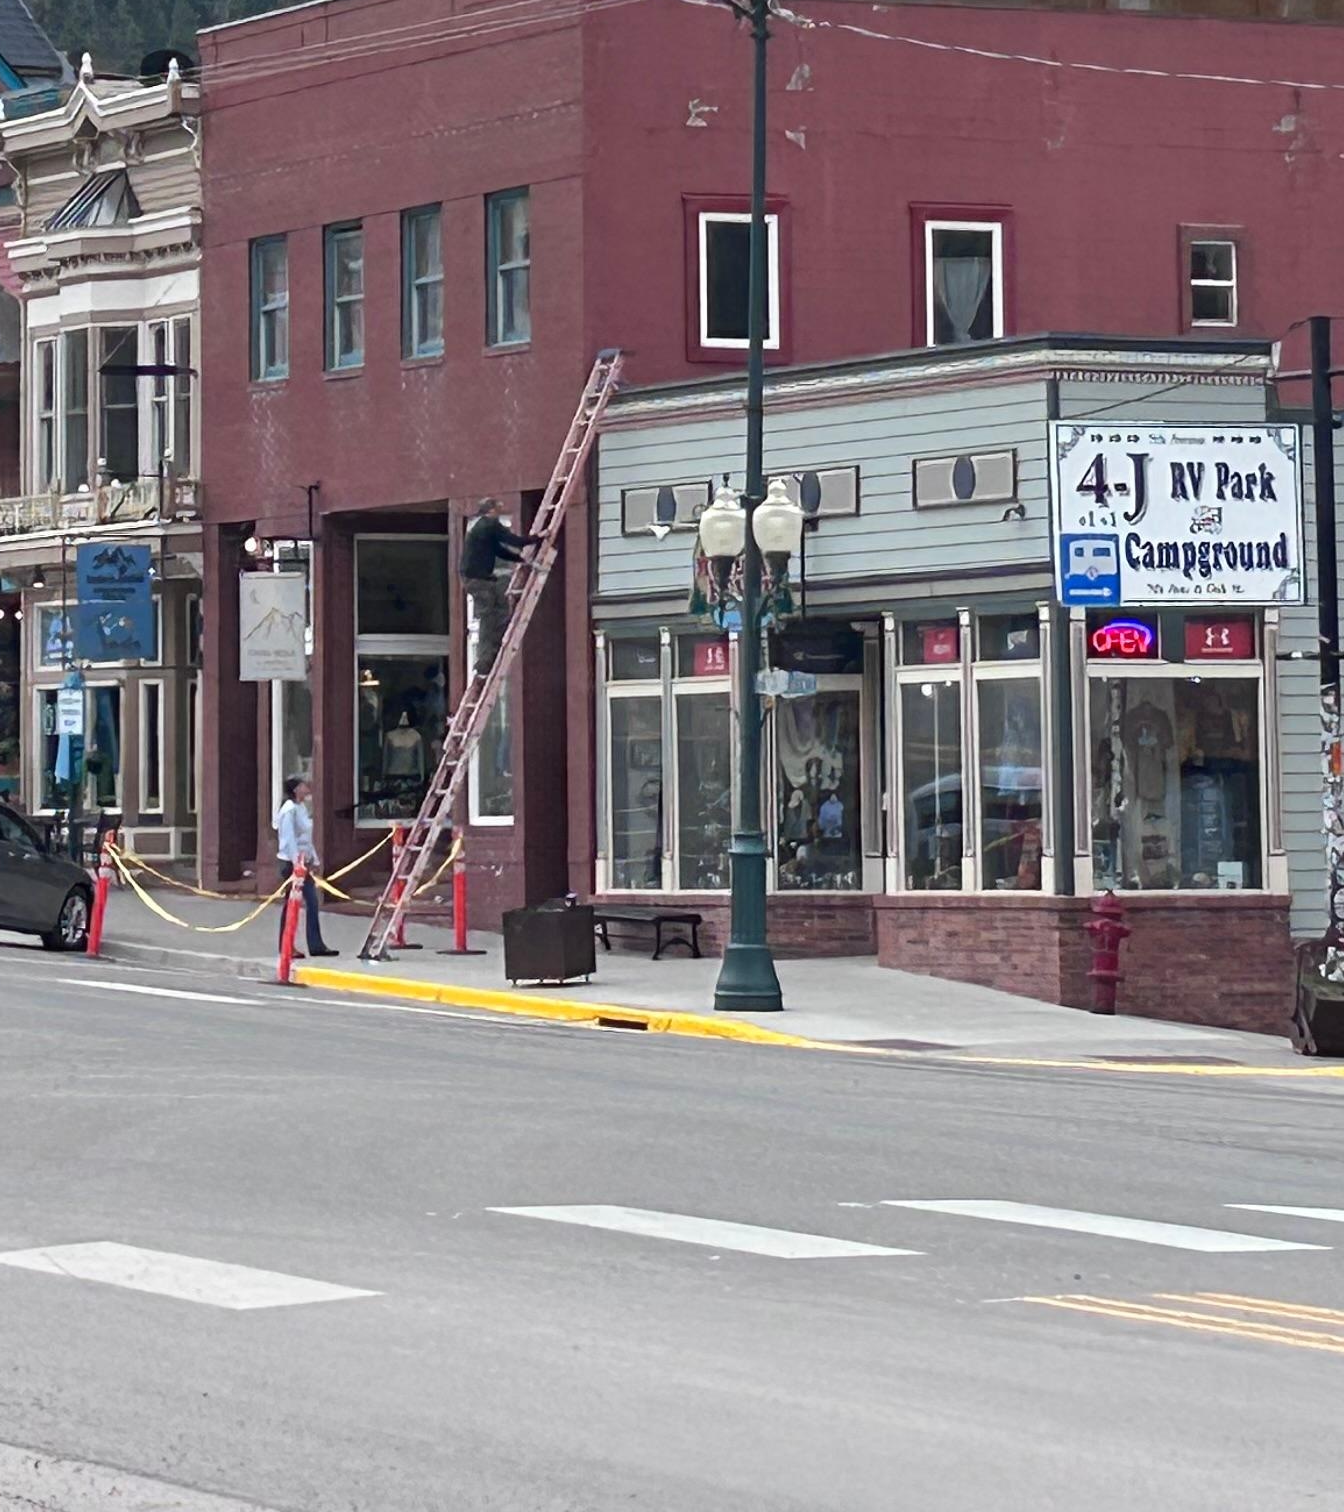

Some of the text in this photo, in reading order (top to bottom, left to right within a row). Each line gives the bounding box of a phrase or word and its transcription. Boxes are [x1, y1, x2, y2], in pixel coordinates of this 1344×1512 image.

[1076, 452, 1151, 524] 4-J
[1169, 461, 1205, 501] RV
[1214, 461, 1278, 502] Park
[1124, 531, 1289, 580] Campground
